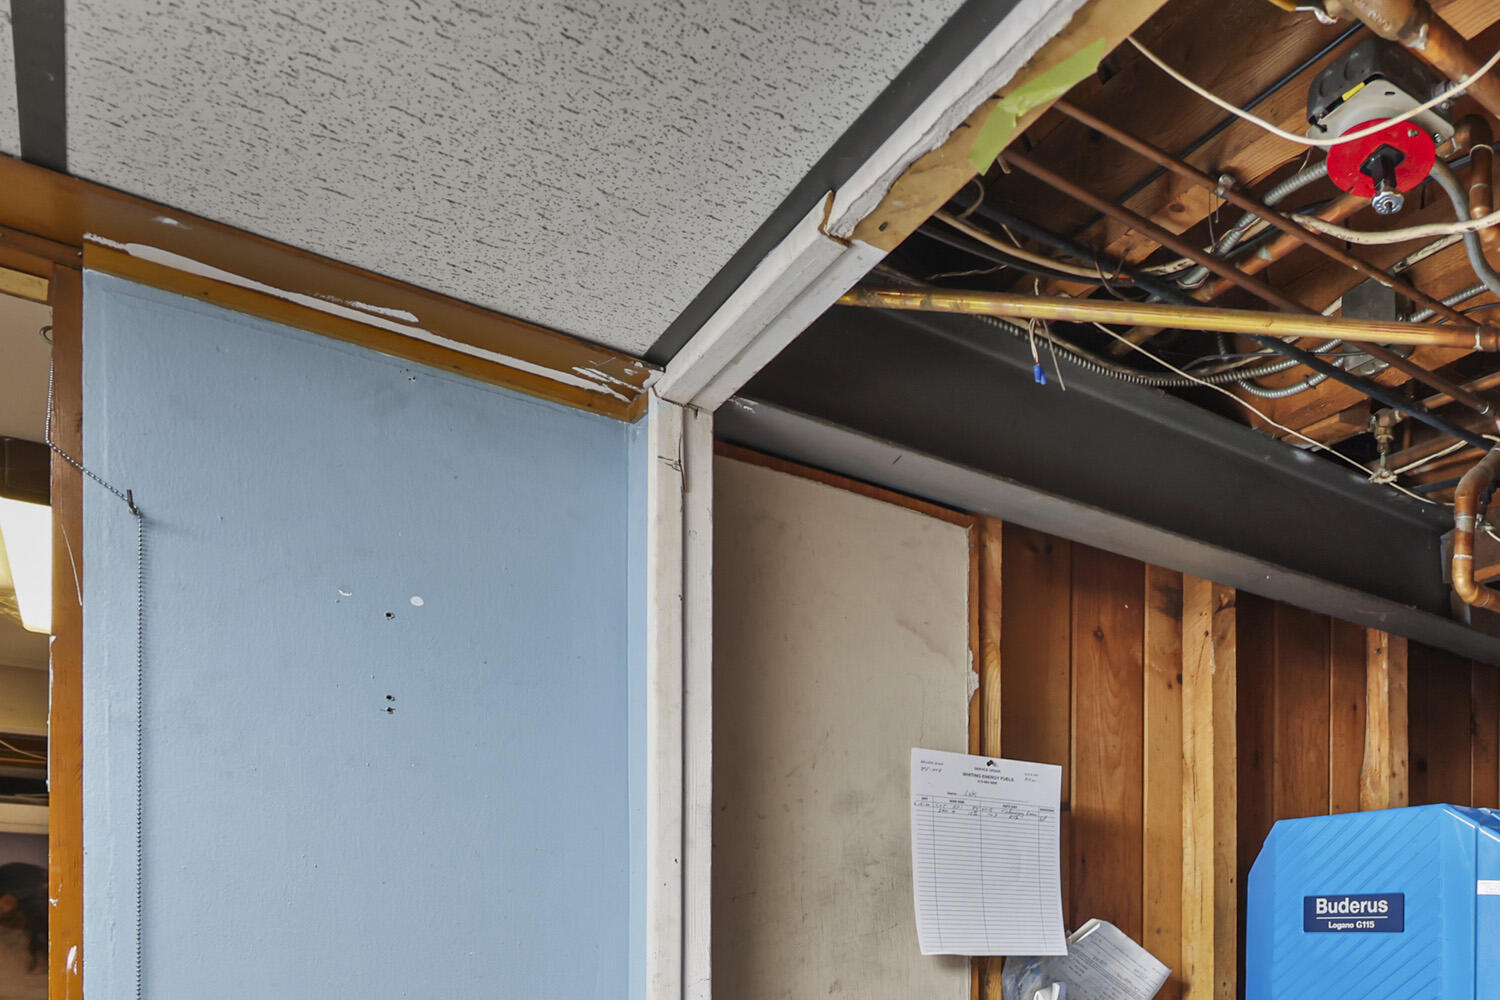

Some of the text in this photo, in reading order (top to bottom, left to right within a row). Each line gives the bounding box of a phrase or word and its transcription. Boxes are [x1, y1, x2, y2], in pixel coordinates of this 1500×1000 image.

[1316, 897, 1389, 914] Buderus
[1328, 920, 1375, 930] Logano G115
